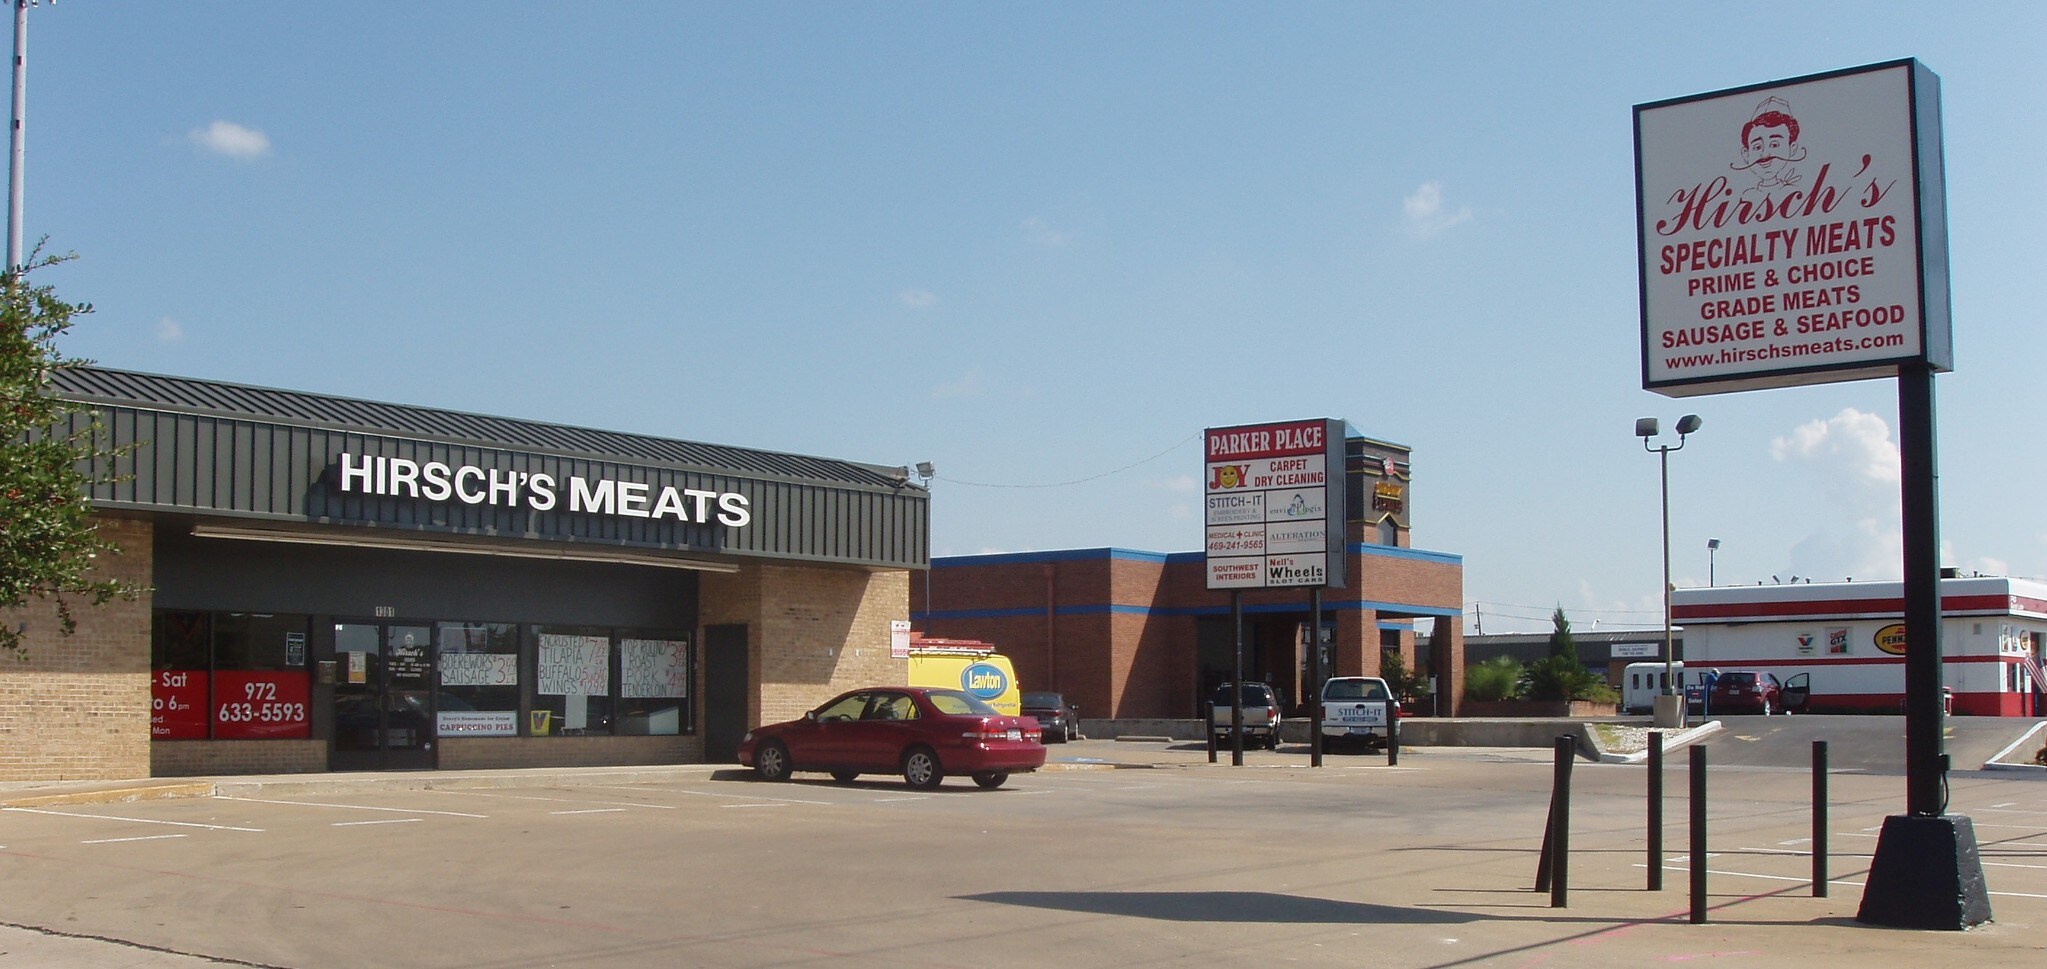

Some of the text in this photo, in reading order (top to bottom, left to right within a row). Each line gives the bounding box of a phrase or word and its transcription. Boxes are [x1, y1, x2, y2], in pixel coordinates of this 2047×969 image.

[1656, 154, 1896, 236] Hirsch's
[1660, 215, 1896, 275] SPECIALTY MEATS
[1688, 256, 1875, 297] PRIME & CHOICE
[1701, 285, 1861, 320] GRADE MEATS
[1662, 304, 1905, 349] SAUSAGE & SEAFOOD
[1665, 332, 1904, 369] www.hirschsmeats.com
[1210, 426, 1322, 455] PARKER PLACE
[1270, 459, 1308, 472] CARPET
[1254, 472, 1324, 487] DRY CLEANING
[341, 452, 751, 527] HIRSCH'S MEATS
[1209, 495, 1262, 509] STITCH-IT
[1244, 530, 1265, 538] CLINIC
[1208, 540, 1263, 550] 469-241-9565
[1213, 564, 1259, 573] SOUTHWEST
[1216, 572, 1256, 580] INTERIORS
[1270, 565, 1323, 579] Wheels
[539, 635, 585, 648] ENCRUSTED
[1830, 634, 1847, 645] GTX
[1882, 635, 1904, 644] PENN
[542, 647, 584, 664] TILAPIA
[629, 654, 656, 668] ROAST
[162, 672, 188, 687] Sat
[442, 669, 491, 684] SAUSAGE
[540, 665, 581, 680] BUFFALO
[627, 668, 661, 683] PORK
[969, 670, 1001, 689] Lawton
[245, 683, 276, 700] 972
[542, 679, 578, 694] WINGS
[622, 683, 667, 696] TENDERLOIN
[219, 703, 304, 722] 633-5593
[1338, 708, 1382, 716] STITCH-IT
[152, 727, 171, 735] Mon
[440, 723, 514, 731] CAPPUCCINO PIES
